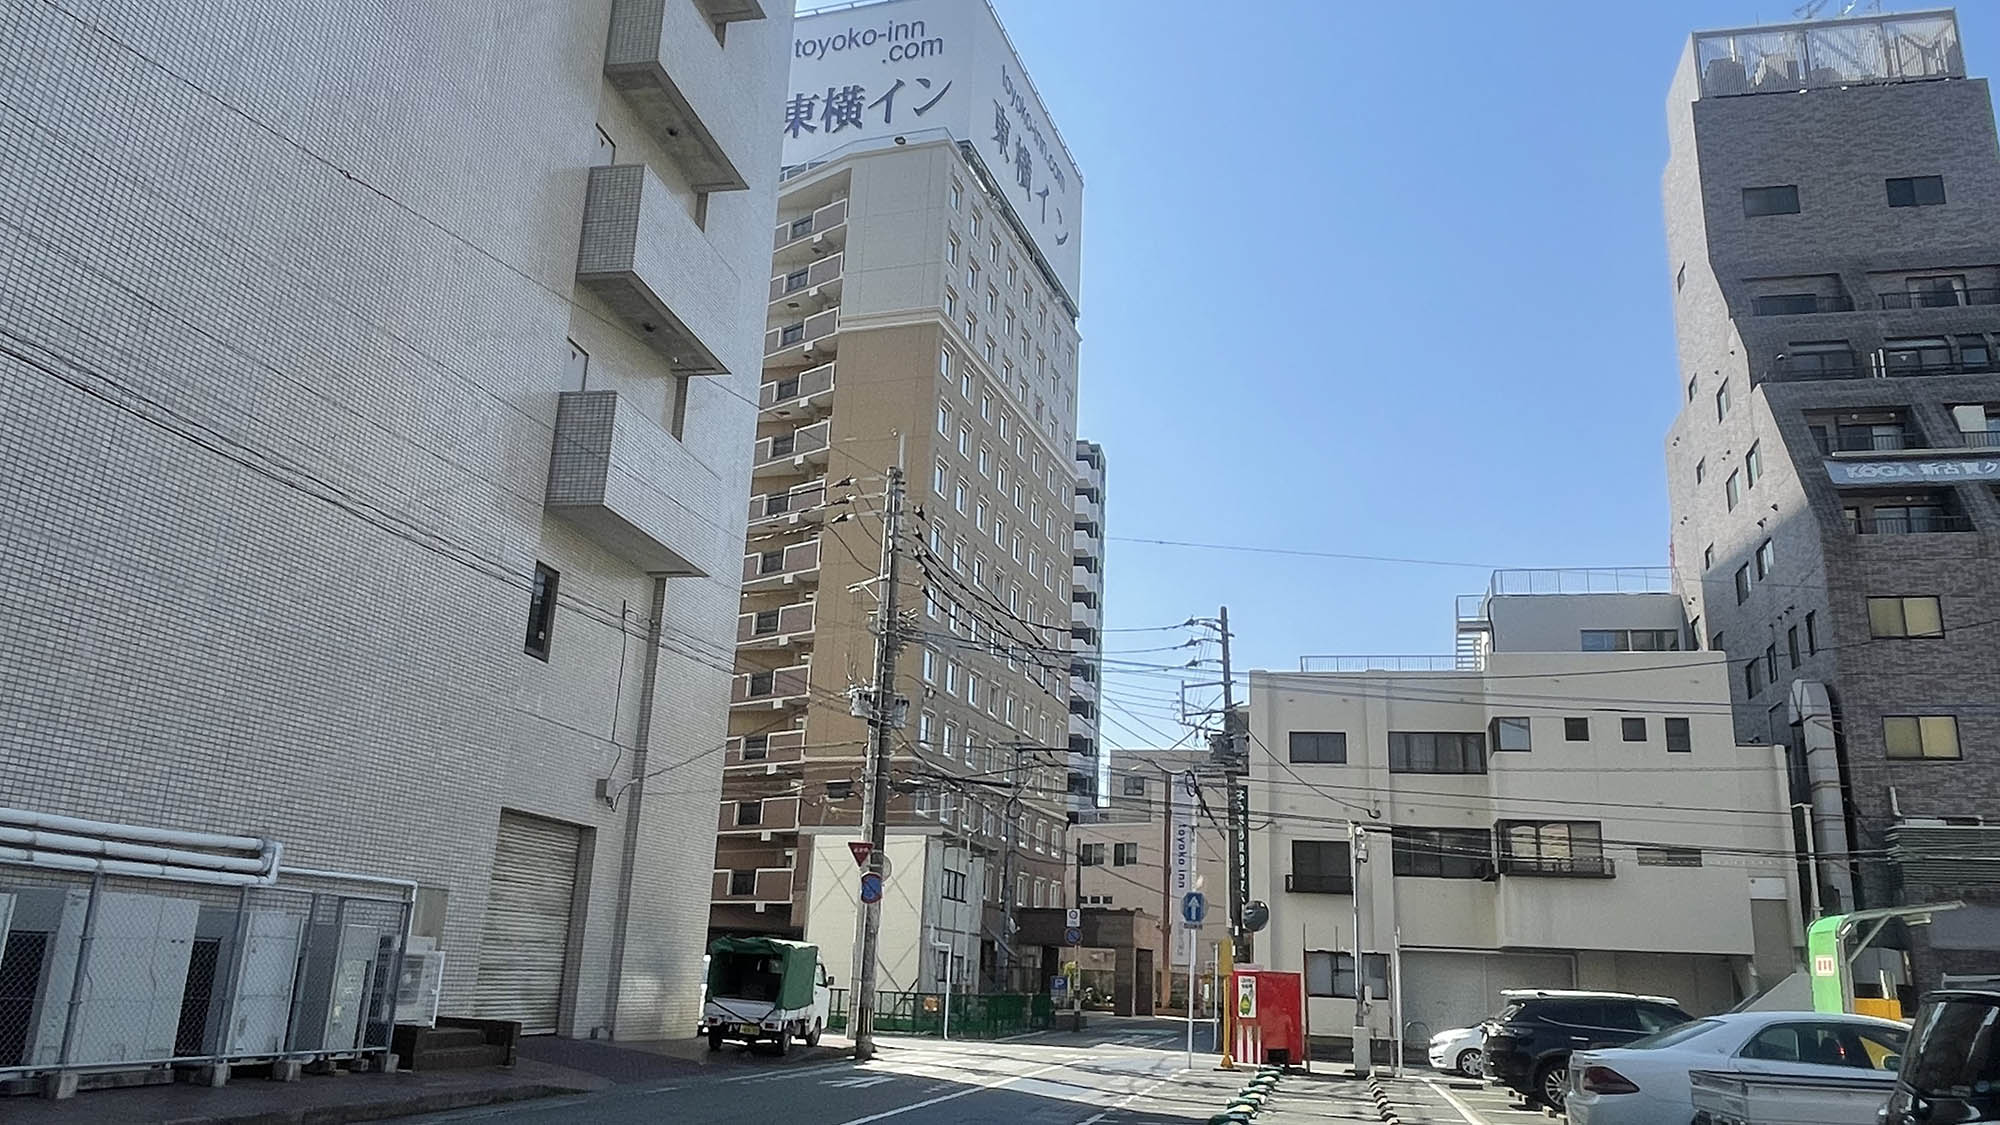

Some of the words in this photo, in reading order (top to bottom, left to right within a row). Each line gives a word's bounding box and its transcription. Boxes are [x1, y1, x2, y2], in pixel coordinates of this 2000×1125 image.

[794, 20, 925, 60] toyoko-inn
[881, 37, 944, 64] .com
[784, 78, 953, 139] 東横イン
[991, 98, 1069, 246] 東横イン
[1846, 463, 1914, 478] KOGA
[1177, 824, 1186, 866] toyoko
[1178, 870, 1186, 888] inn
